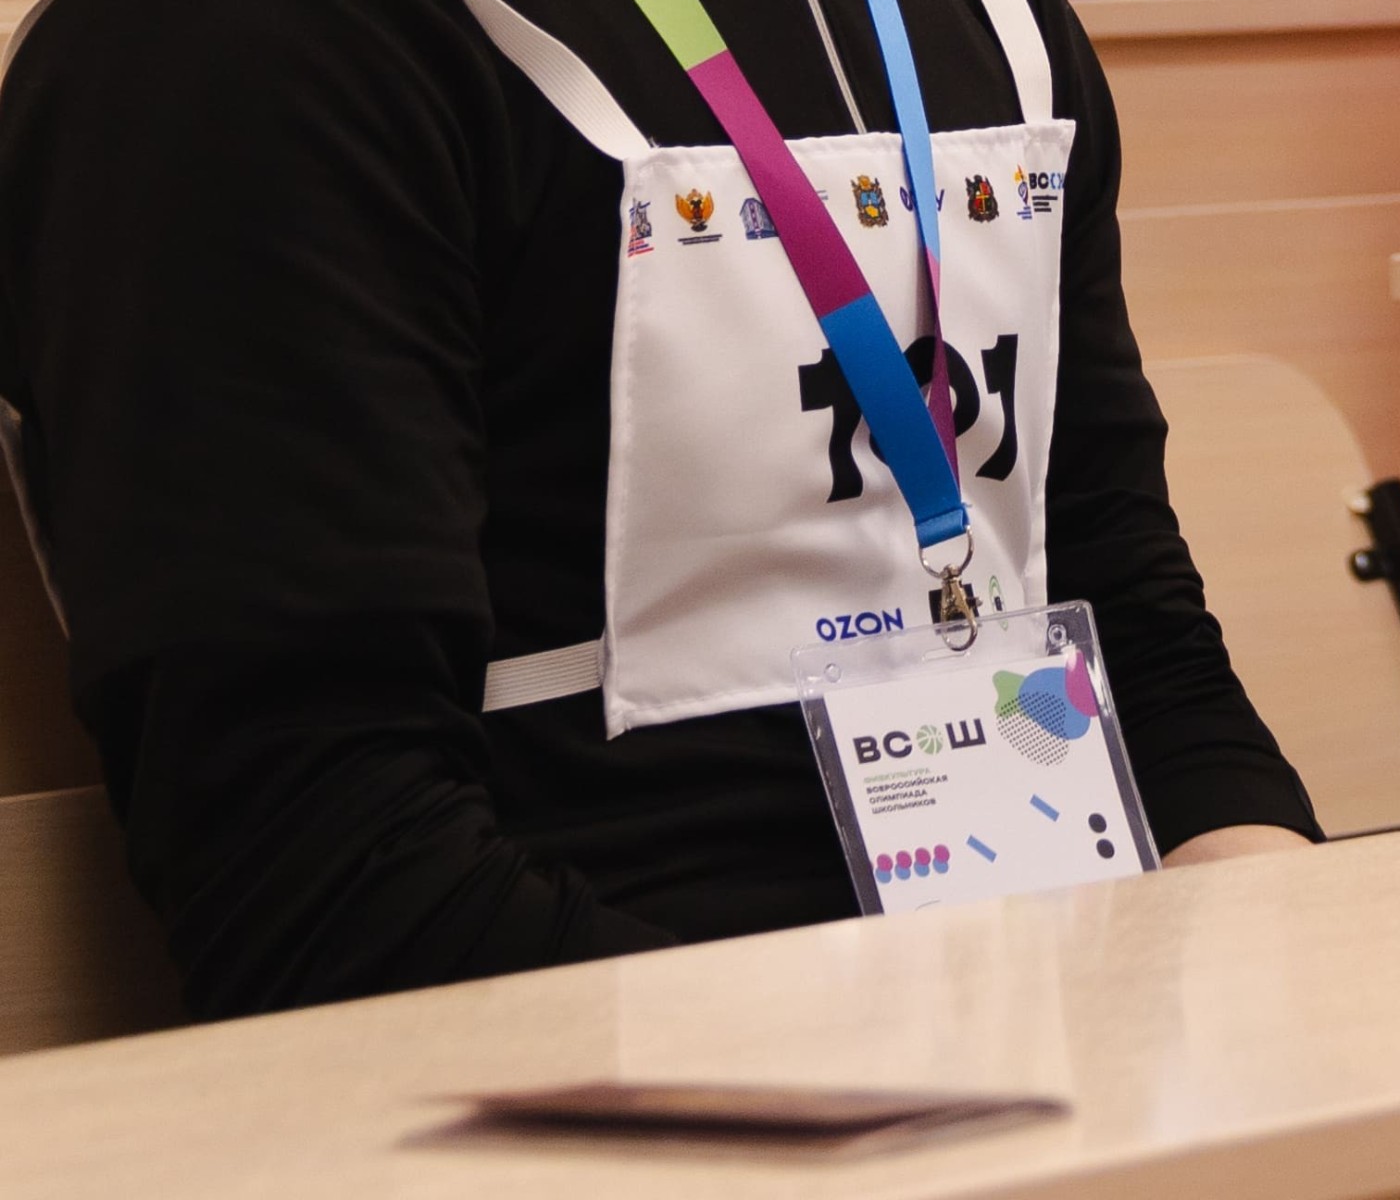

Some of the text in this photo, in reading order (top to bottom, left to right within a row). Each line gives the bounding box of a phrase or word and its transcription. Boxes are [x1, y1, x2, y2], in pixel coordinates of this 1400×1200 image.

[816, 607, 904, 642] OZON
[866, 774, 948, 794] ВСЕРОССИЙСКАЯ
[869, 788, 928, 804] ОЛИМПИАДА
